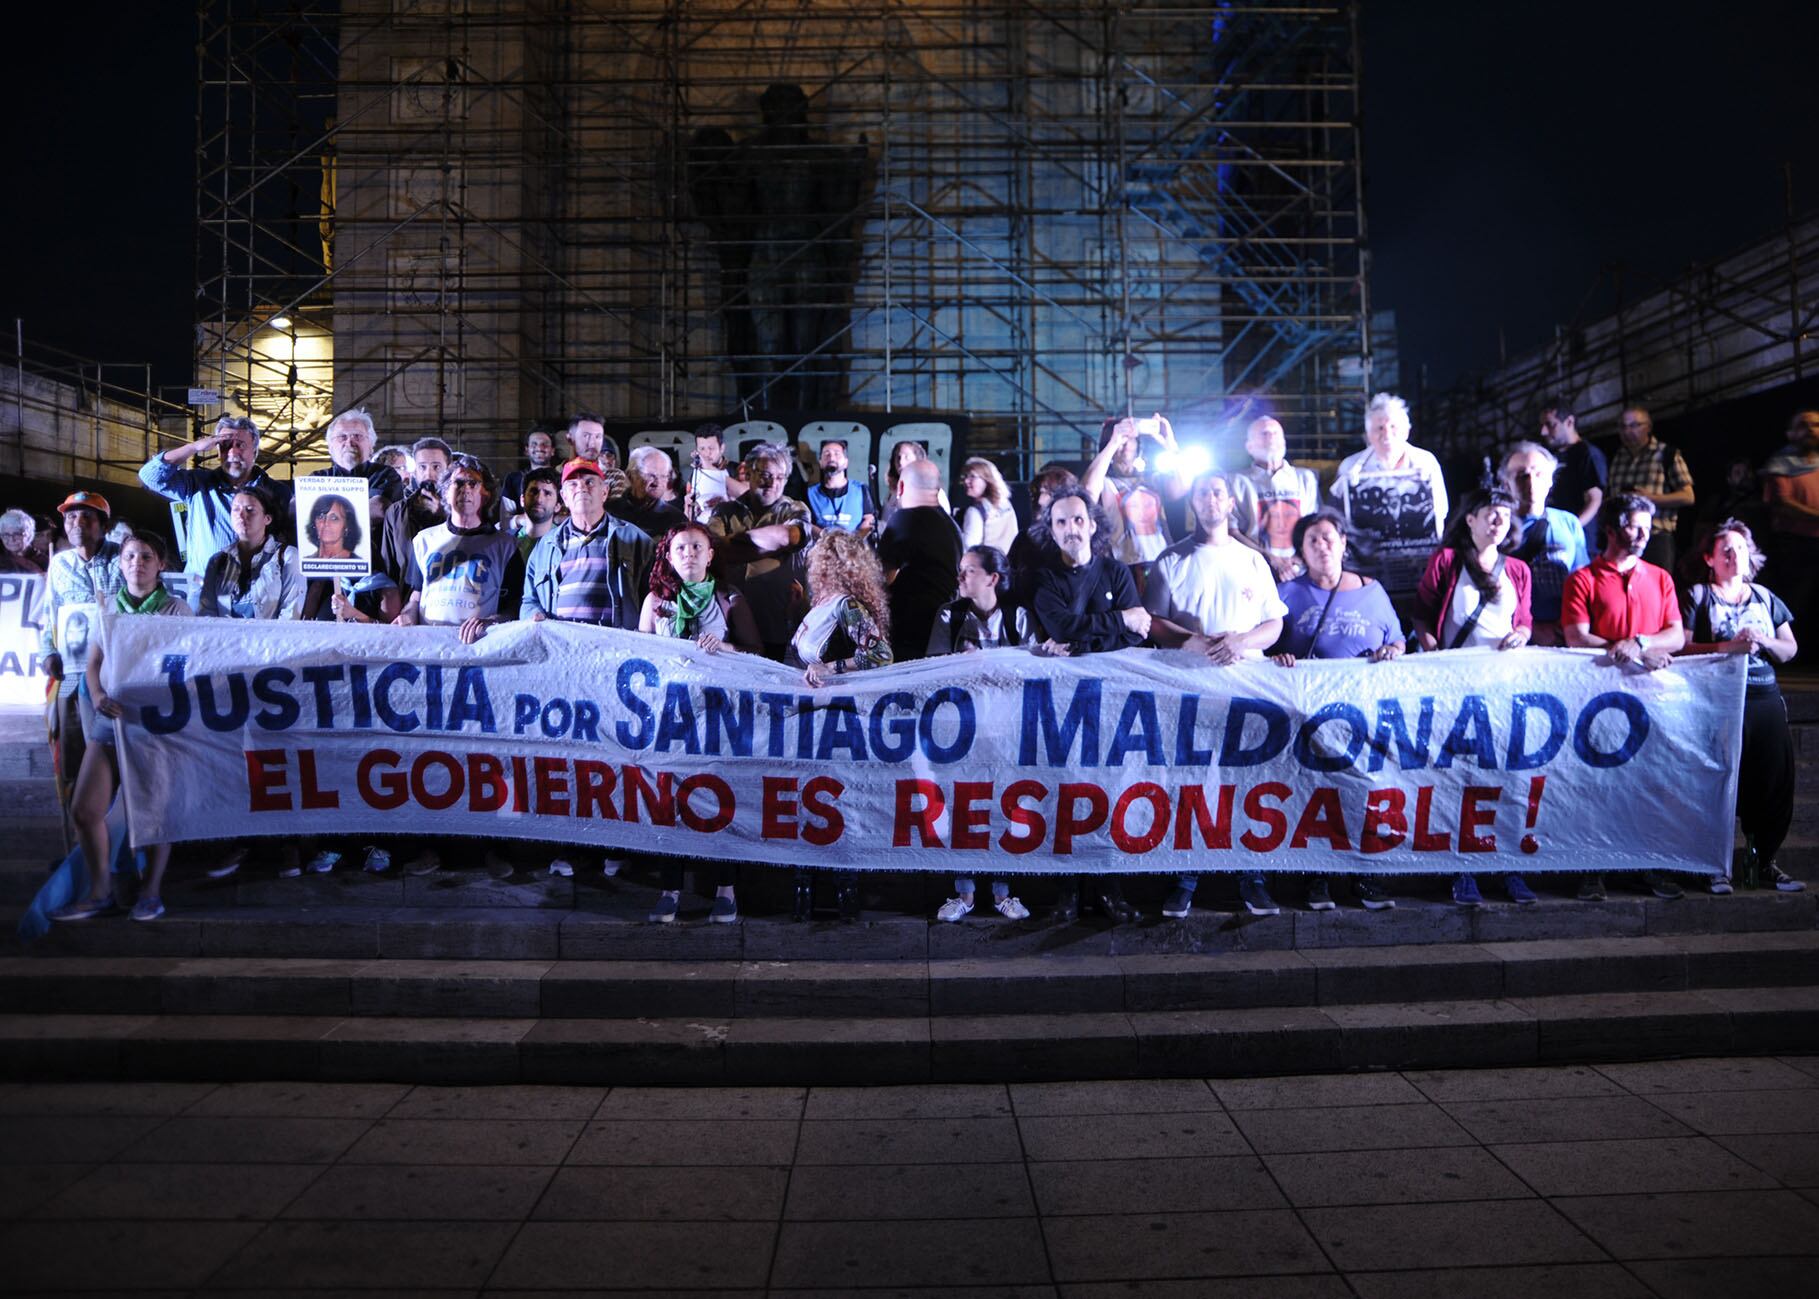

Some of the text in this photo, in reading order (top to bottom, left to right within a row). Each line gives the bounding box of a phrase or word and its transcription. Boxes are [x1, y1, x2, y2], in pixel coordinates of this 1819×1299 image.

[428, 598, 476, 610] OSARIO
[139, 654, 1651, 774] JUSTICIA POR SANTIAGO MALDONADO
[245, 749, 340, 812] EL
[356, 748, 736, 834] GOBIERNO
[761, 775, 845, 846] ES
